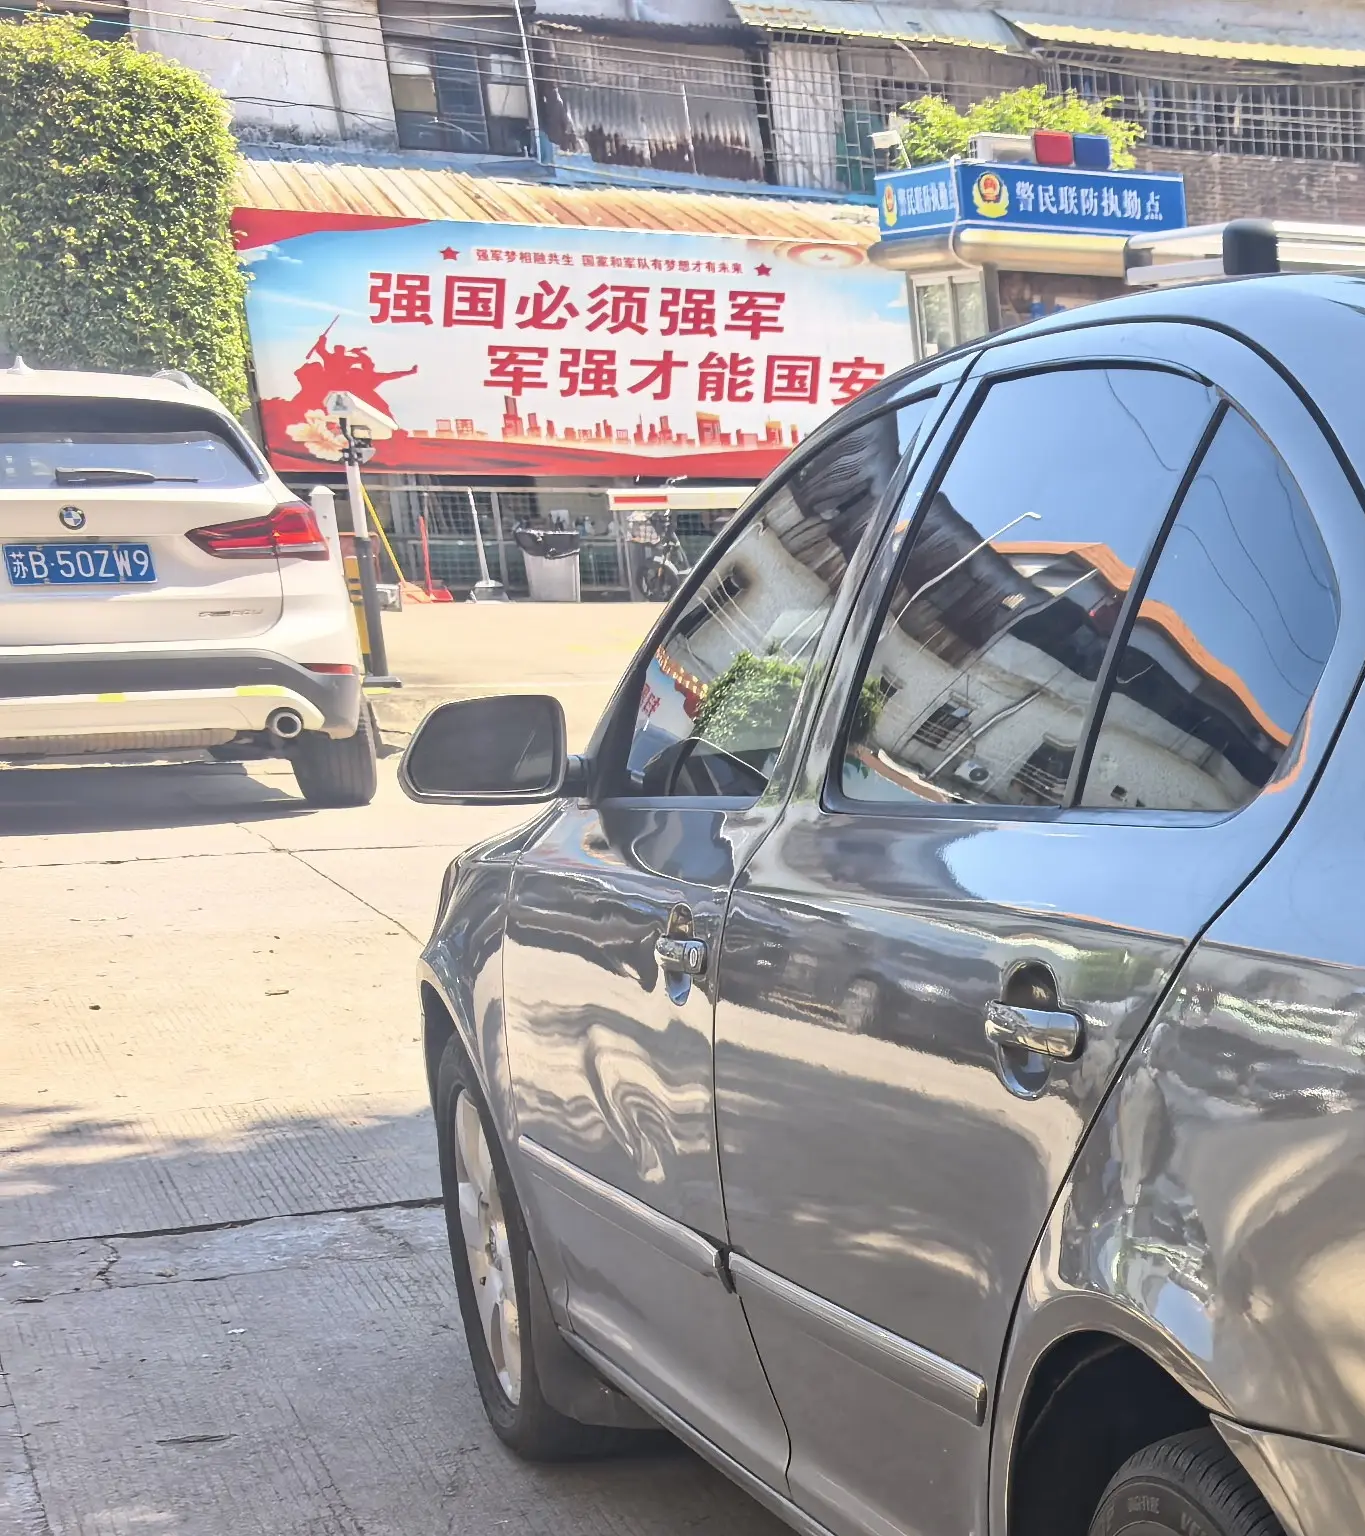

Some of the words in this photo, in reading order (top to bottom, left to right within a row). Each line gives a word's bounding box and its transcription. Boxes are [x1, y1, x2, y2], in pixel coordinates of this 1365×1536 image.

[1015, 180, 1163, 221] 警民联防执勤点
[368, 271, 786, 341] 强国必须强军
[481, 345, 887, 408] 军强才能国安
